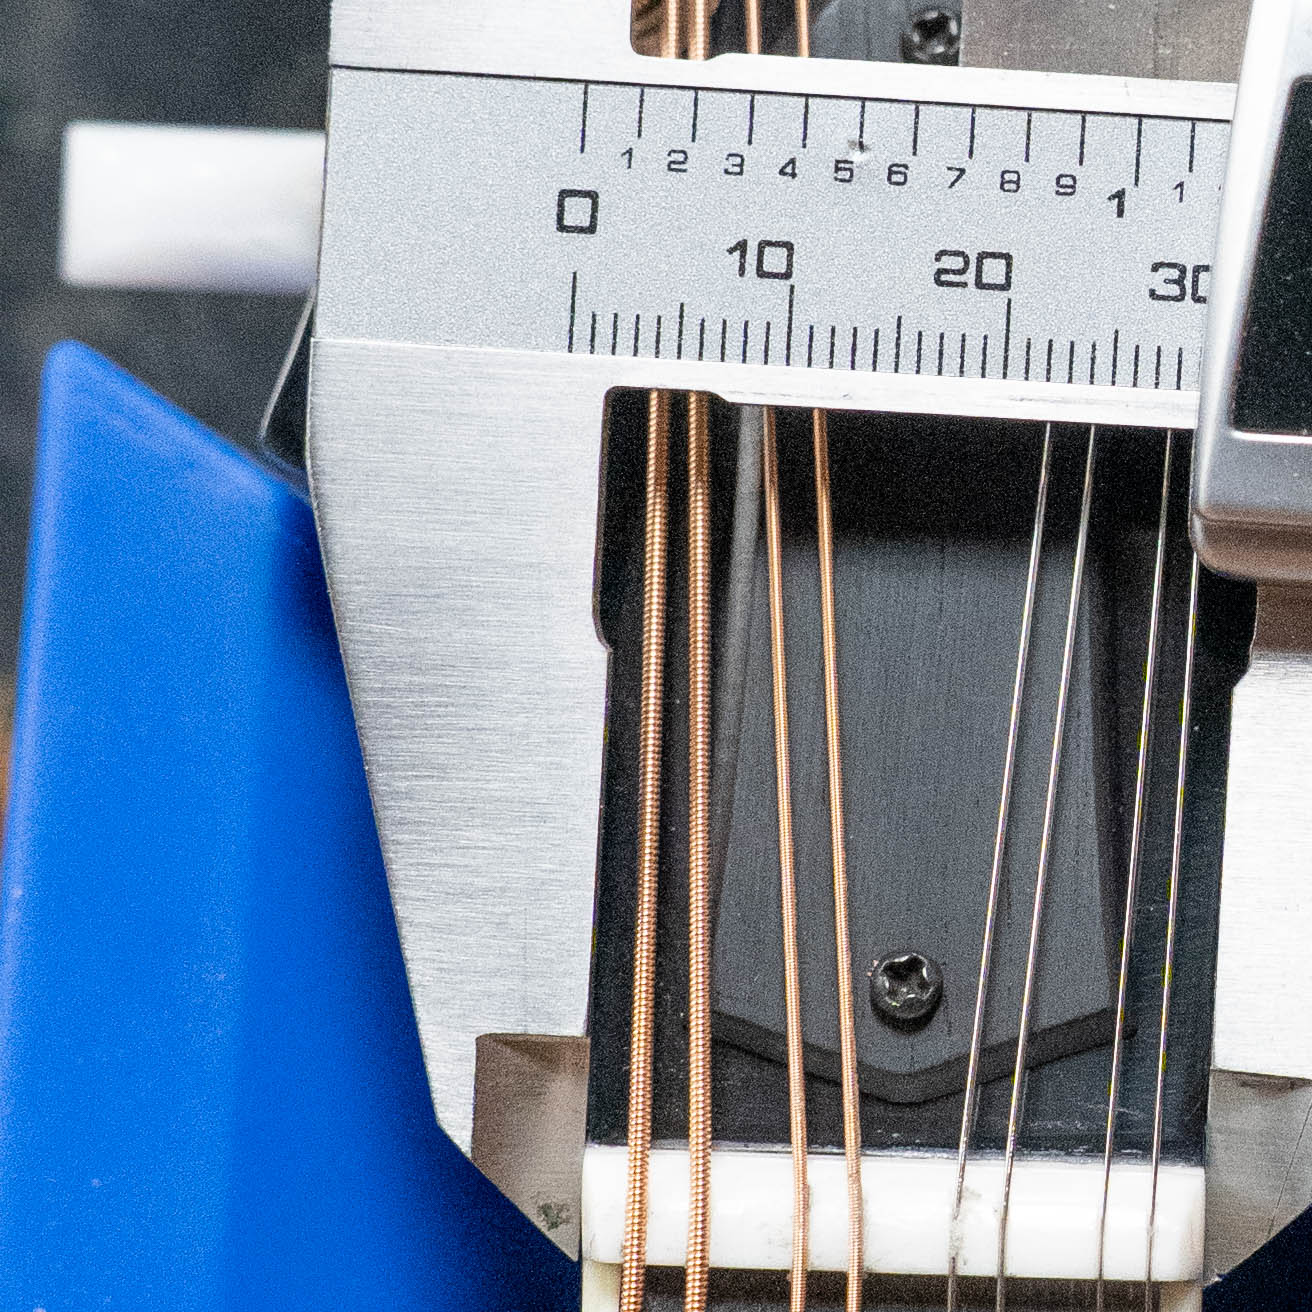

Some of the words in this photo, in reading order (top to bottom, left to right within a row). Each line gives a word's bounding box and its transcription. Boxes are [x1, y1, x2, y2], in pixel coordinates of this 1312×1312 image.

[620, 147, 633, 169] 1
[666, 149, 688, 173] 2
[724, 153, 745, 176] 3
[778, 157, 797, 179] 4
[833, 159, 854, 183] 5
[886, 163, 909, 186] 6
[946, 166, 966, 188] 7
[1000, 169, 1021, 193] 8
[1055, 174, 1077, 196] 9
[1107, 188, 1126, 218] 1
[1173, 181, 1185, 203] 1
[556, 189, 599, 234] 0
[727, 239, 794, 280] 10
[933, 249, 1013, 291] 20
